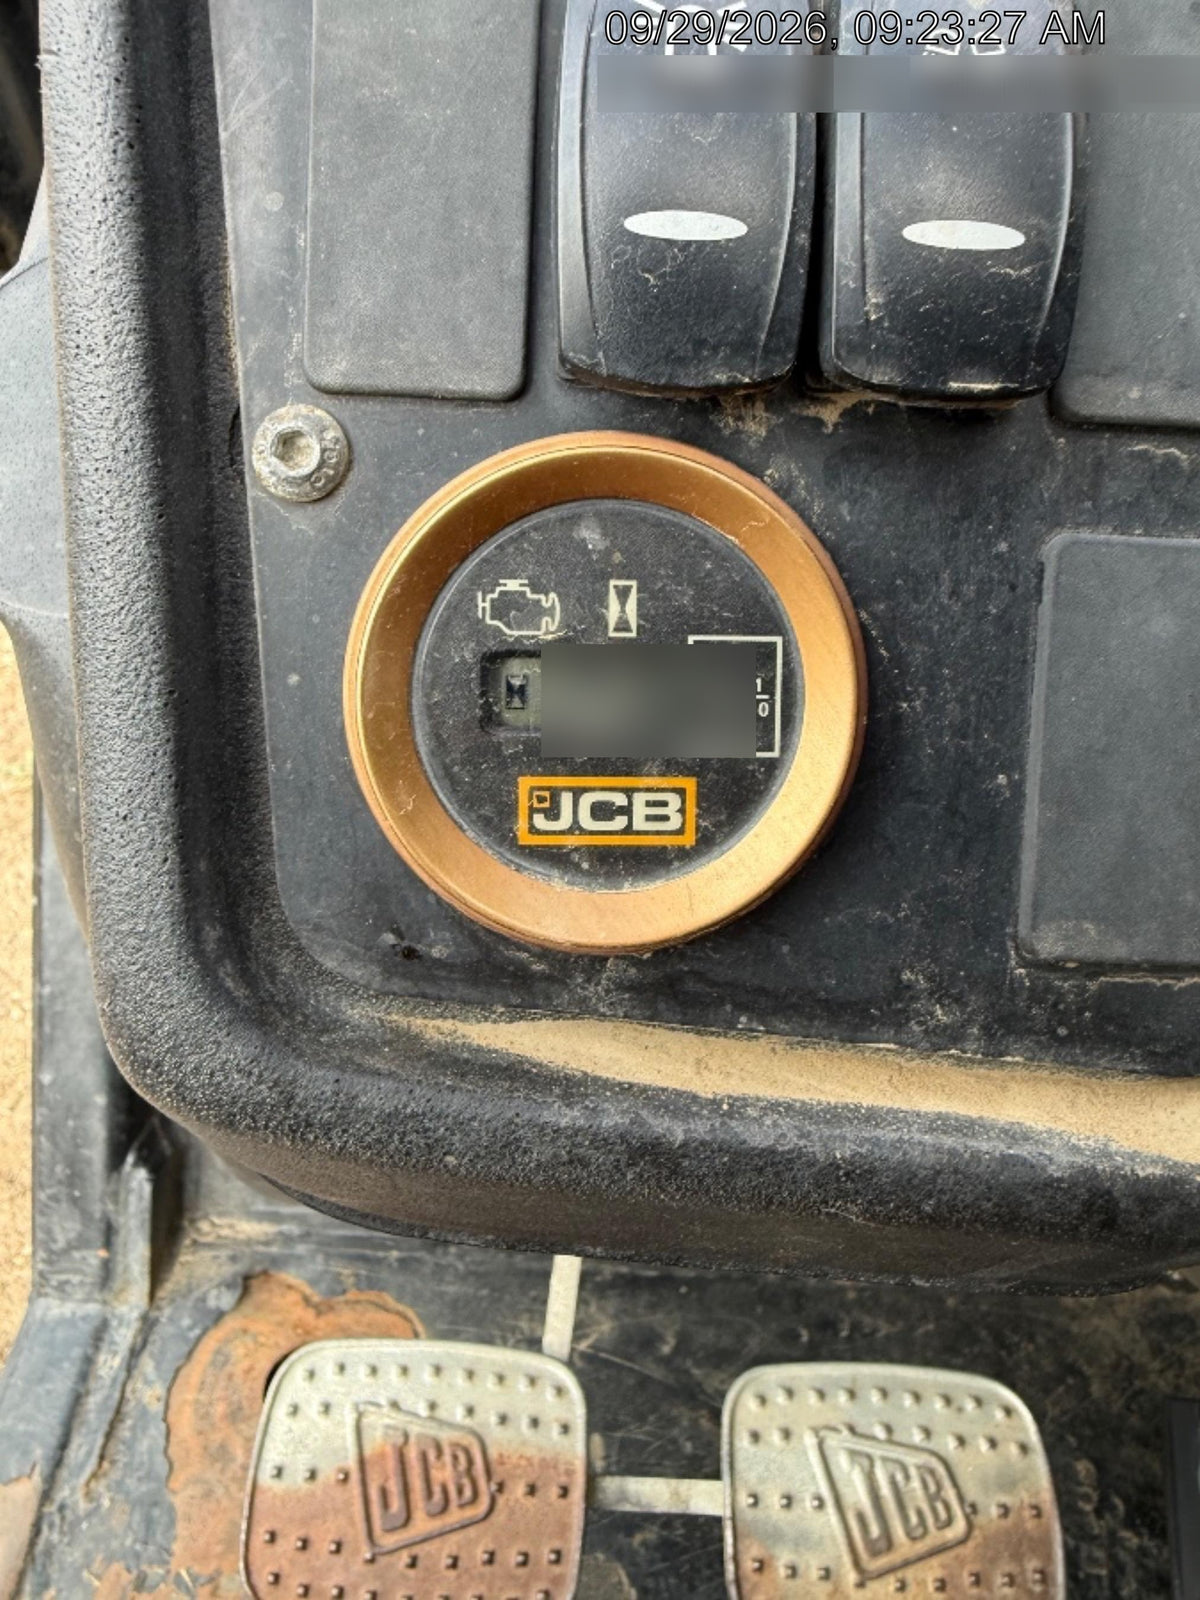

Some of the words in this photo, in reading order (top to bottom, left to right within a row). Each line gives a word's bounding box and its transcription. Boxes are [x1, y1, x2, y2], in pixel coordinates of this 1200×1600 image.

[532, 791, 683, 832] JCB
[377, 1423, 480, 1533] JCB
[841, 1447, 953, 1559] JCB
